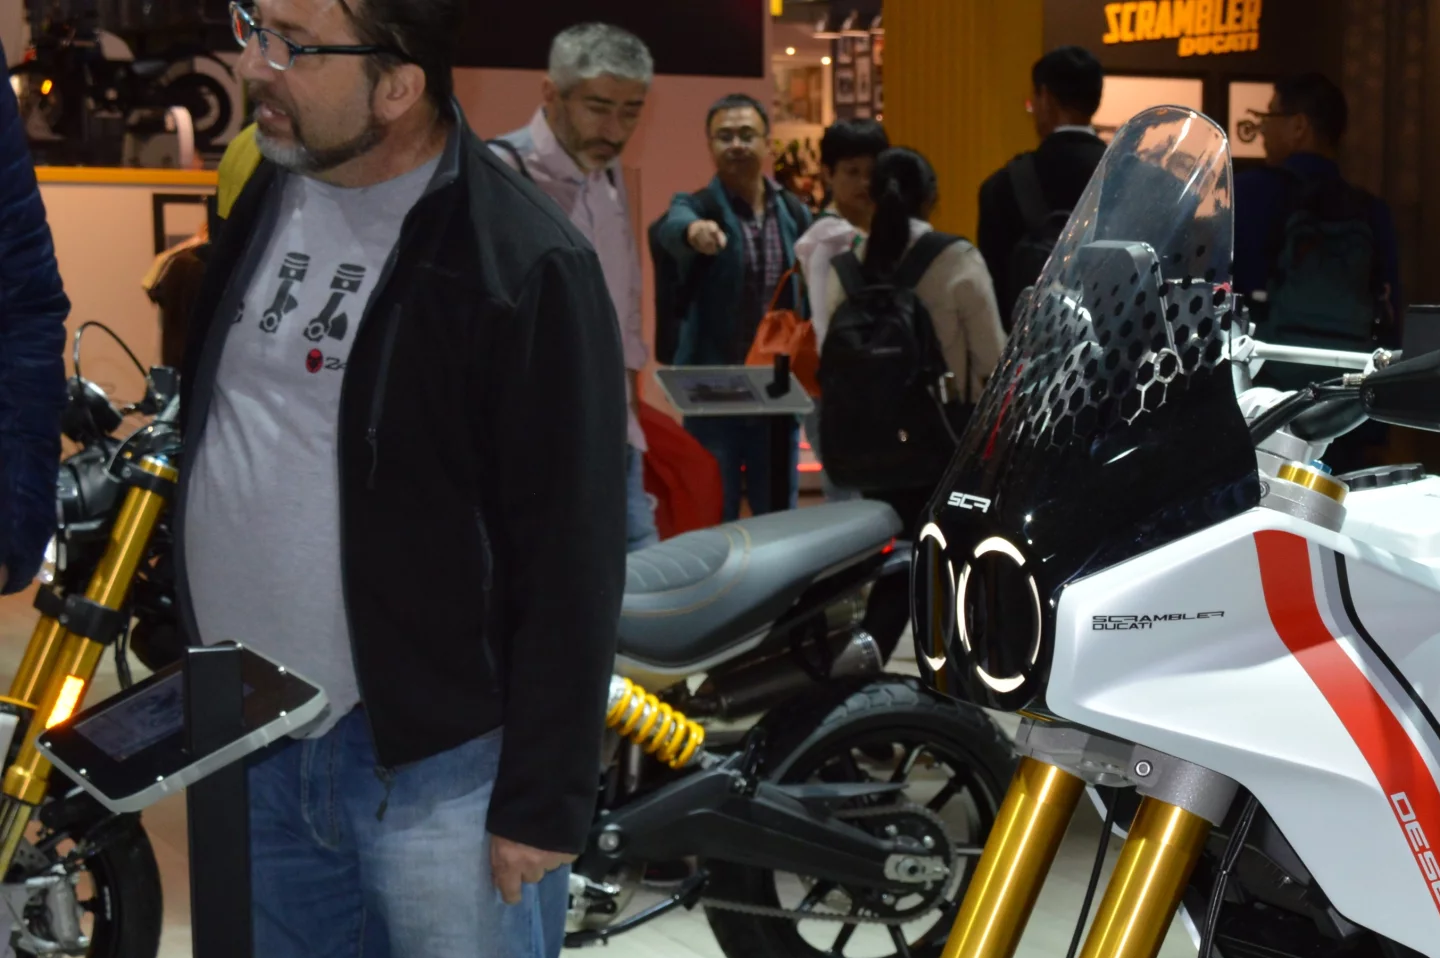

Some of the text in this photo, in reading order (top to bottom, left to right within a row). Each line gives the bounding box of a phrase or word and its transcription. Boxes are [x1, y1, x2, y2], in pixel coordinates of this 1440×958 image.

[1103, 0, 1262, 44] SCRAMBLER
[1177, 31, 1259, 57] DUCATI
[947, 491, 991, 513] SCR
[1092, 610, 1225, 624] SCRAMBLER
[1092, 621, 1153, 631] DUCATI
